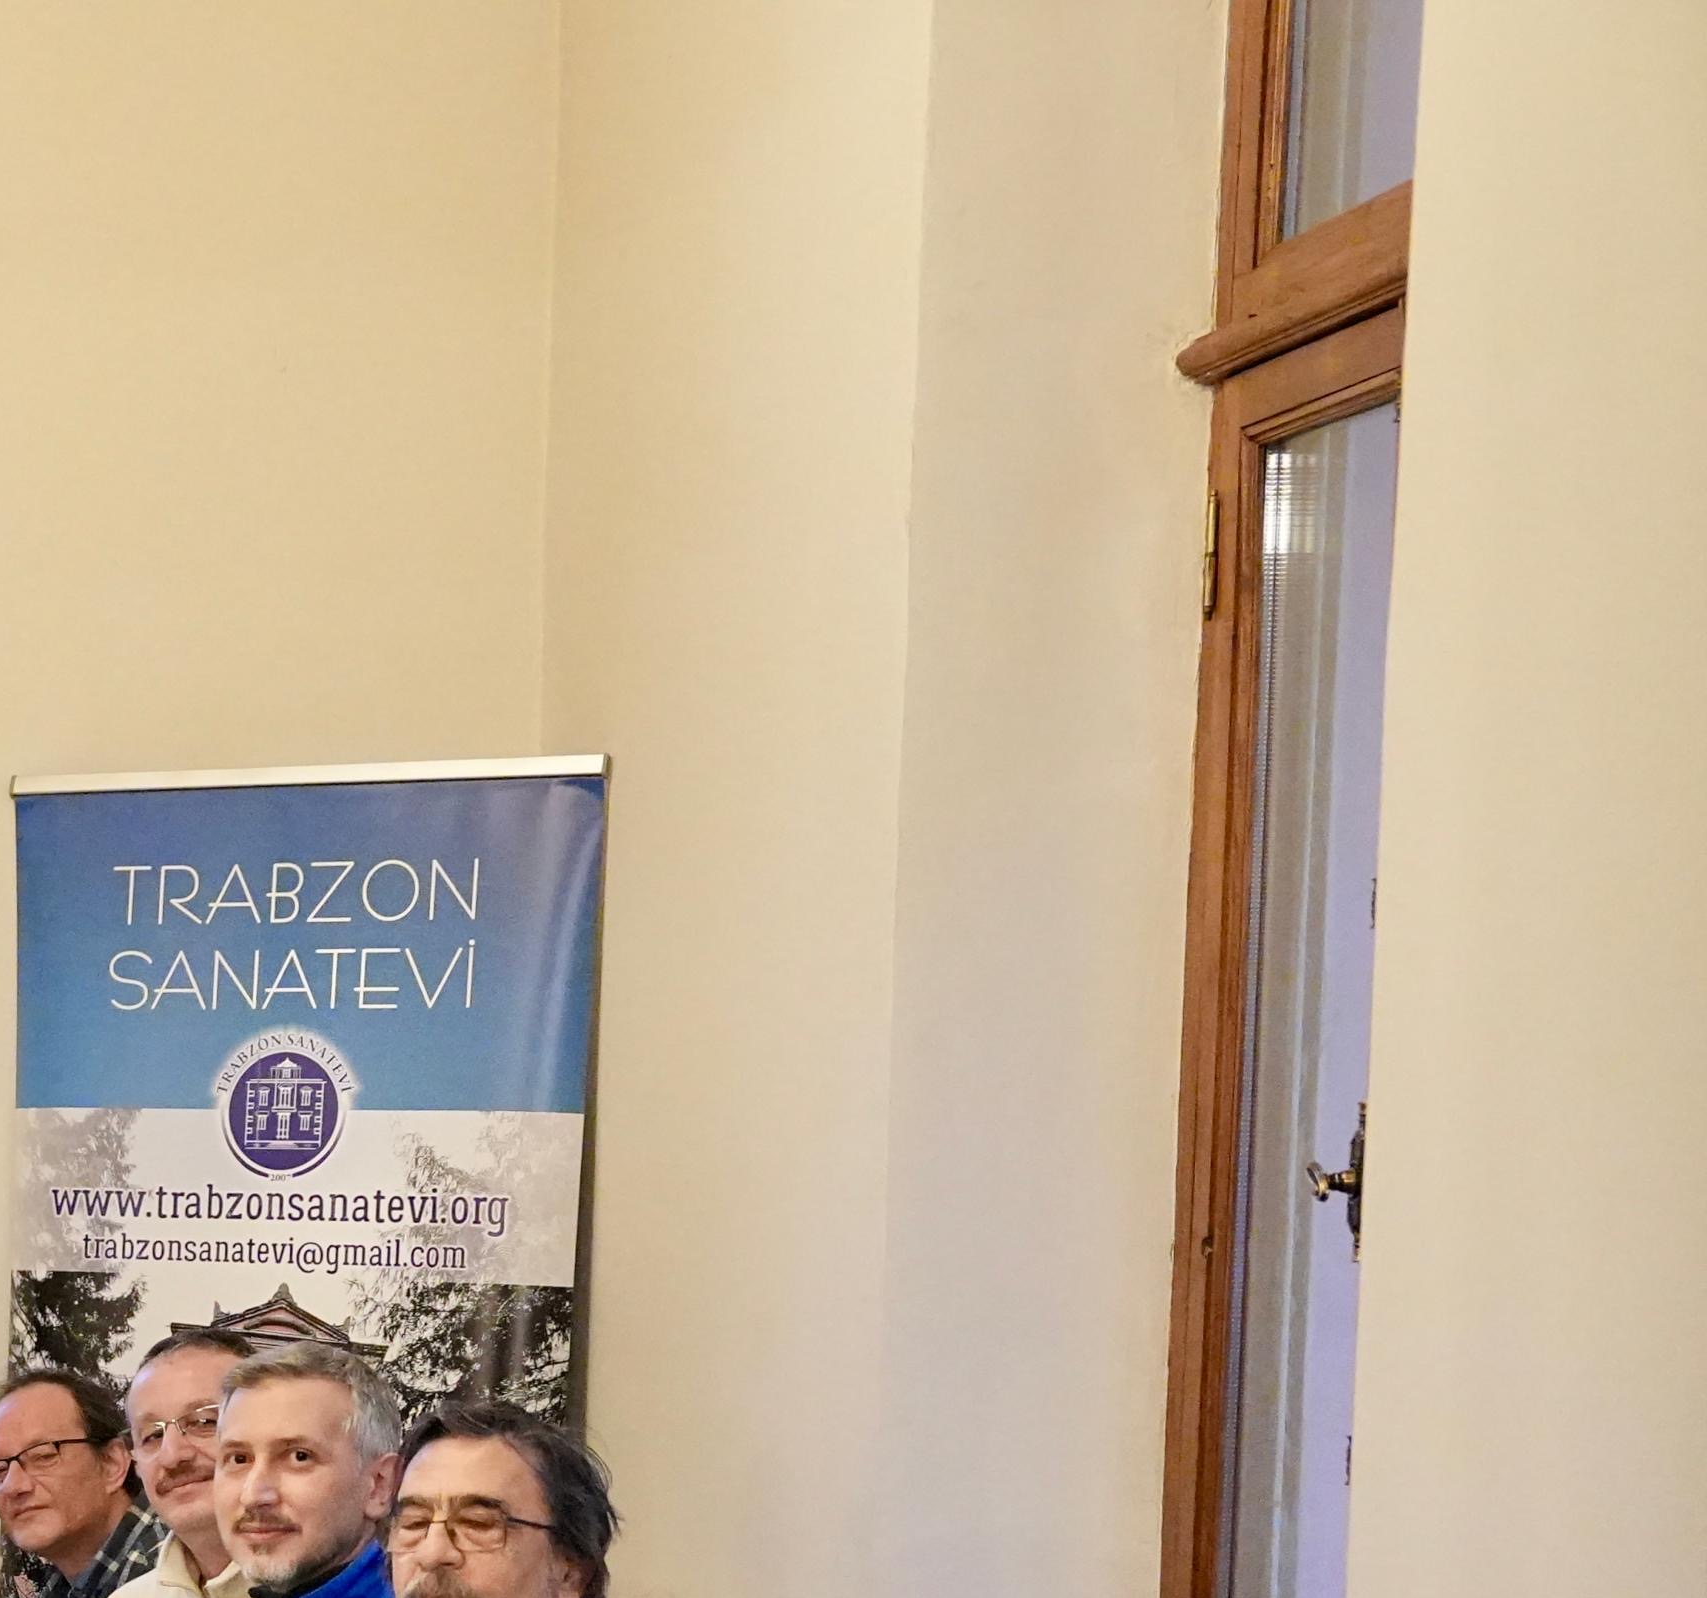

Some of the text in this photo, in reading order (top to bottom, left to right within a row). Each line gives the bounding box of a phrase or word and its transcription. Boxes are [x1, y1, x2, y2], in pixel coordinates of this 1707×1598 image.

[113, 857, 480, 926] TRABZON
[108, 938, 476, 1011] SANATEVİ
[216, 1034, 283, 1094] TRABZON
[51, 1183, 509, 1237] www.trabzonsanatevi.org
[82, 1232, 467, 1275] trabzonsanatevi@gmail.com
